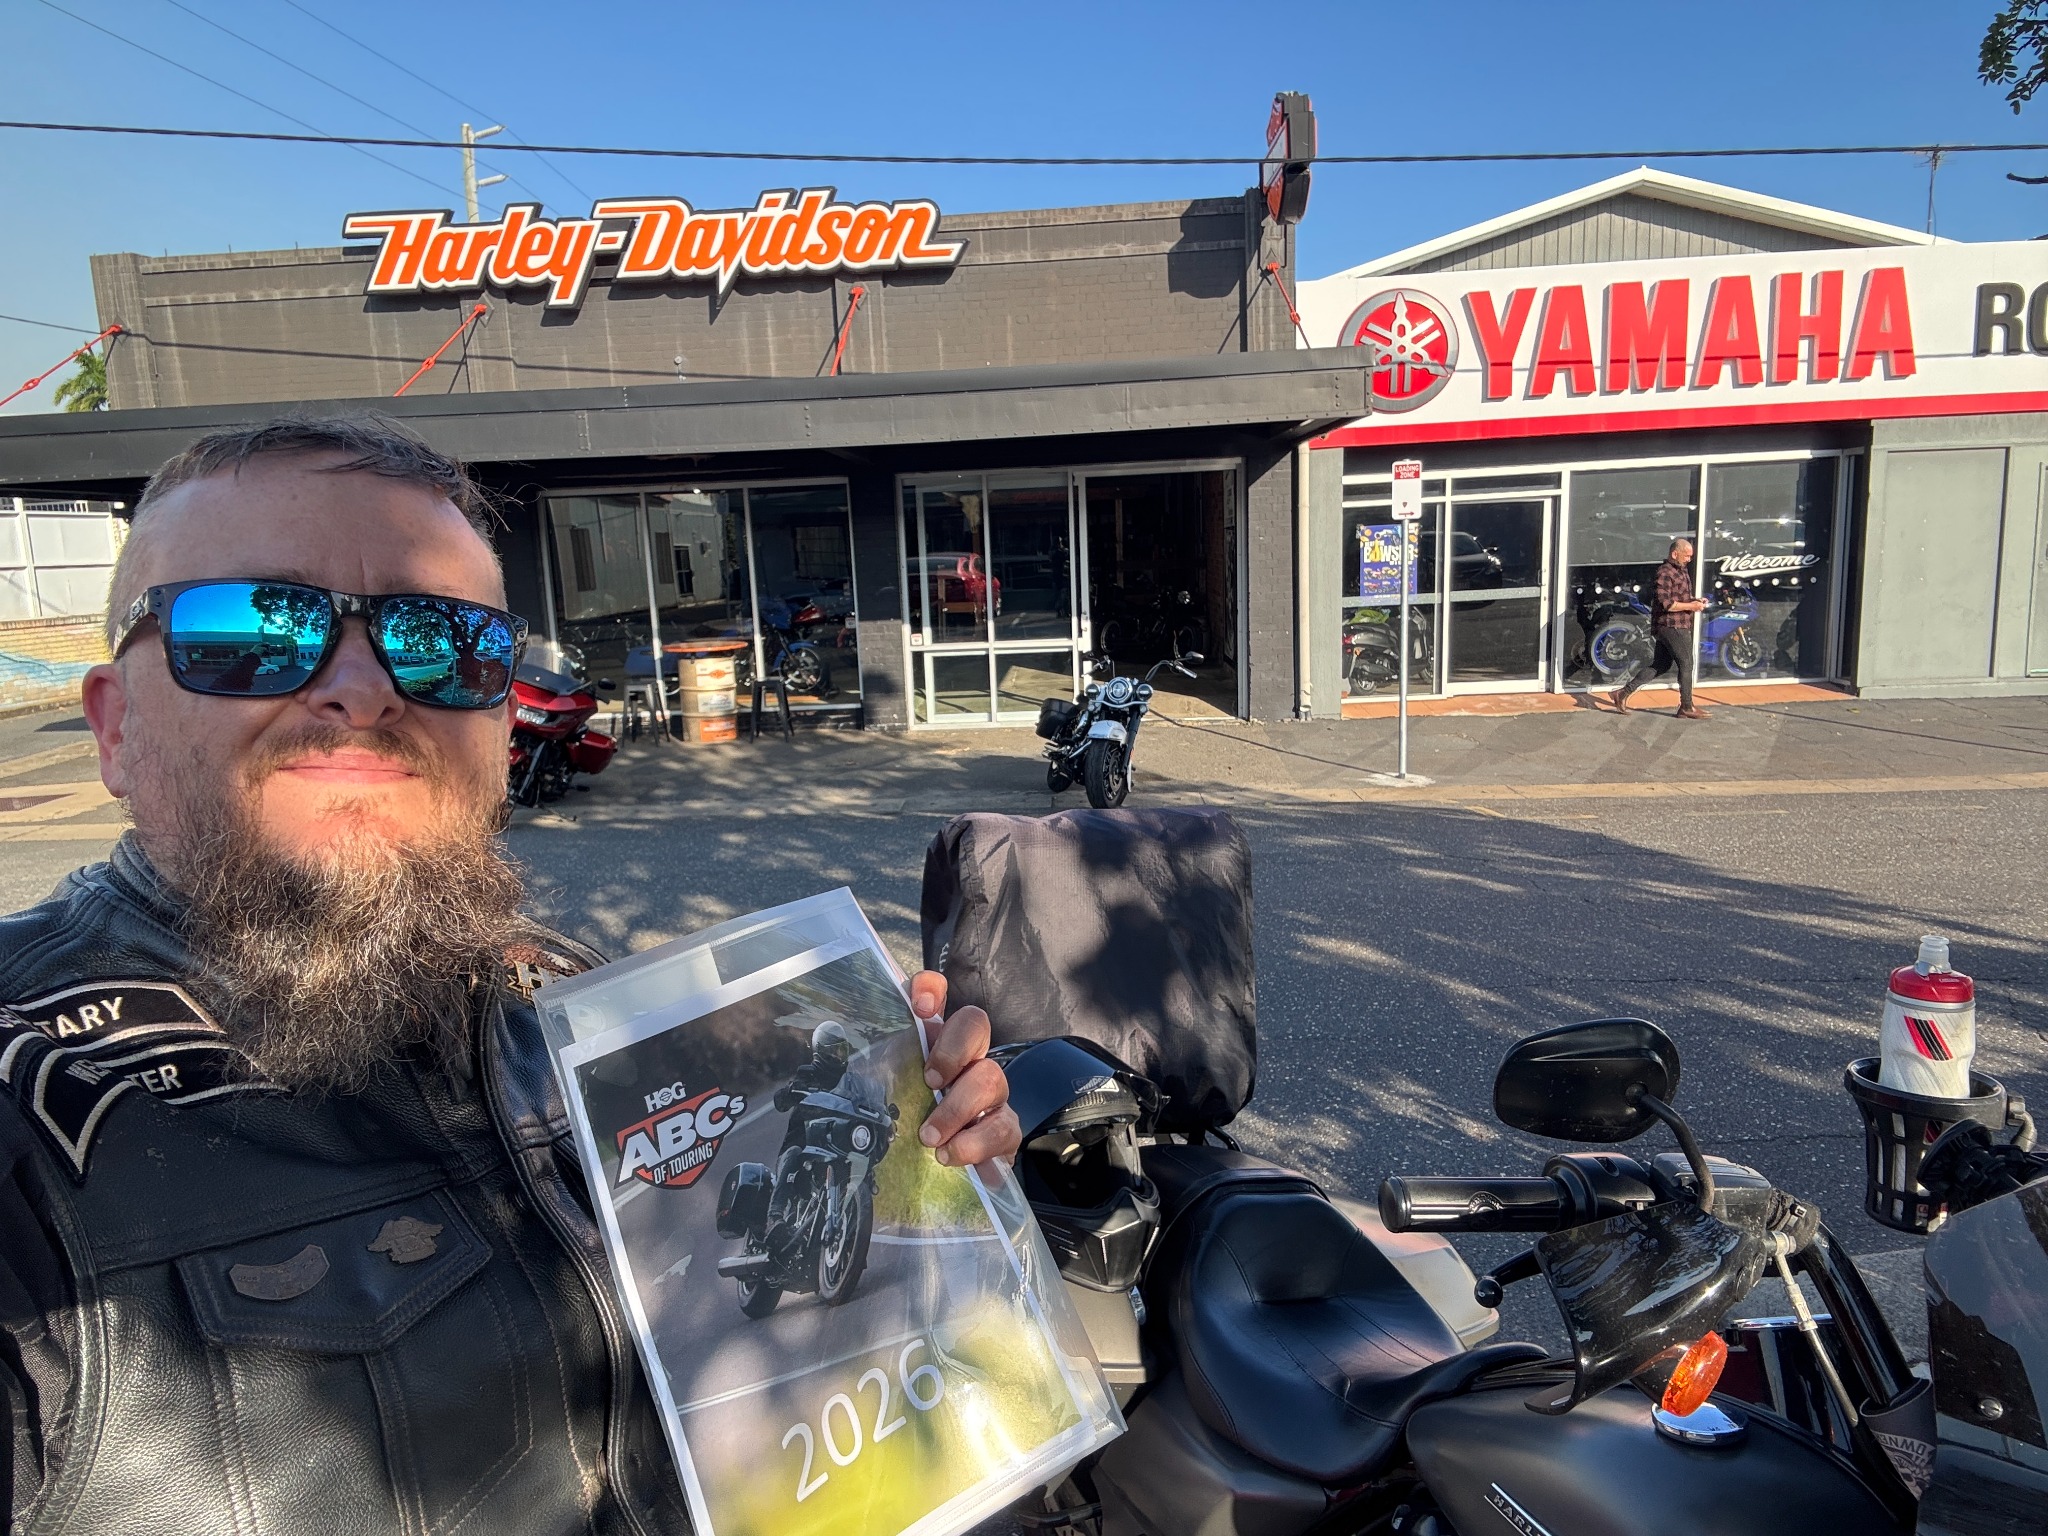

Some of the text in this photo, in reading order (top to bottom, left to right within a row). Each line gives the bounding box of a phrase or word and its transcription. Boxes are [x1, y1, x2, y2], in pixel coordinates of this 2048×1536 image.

[343, 188, 962, 307] Harley-Davidson
[1462, 267, 1917, 402] YAMAHA
[1395, 465, 1420, 473] LOADING
[1400, 471, 1416, 479] ZONE
[1715, 553, 1820, 573] Welcome
[644, 1082, 687, 1113] HOG
[653, 1142, 713, 1185] OF TOURING
[782, 1338, 945, 1503] 2026
[1493, 1494, 1542, 1536] HARL
